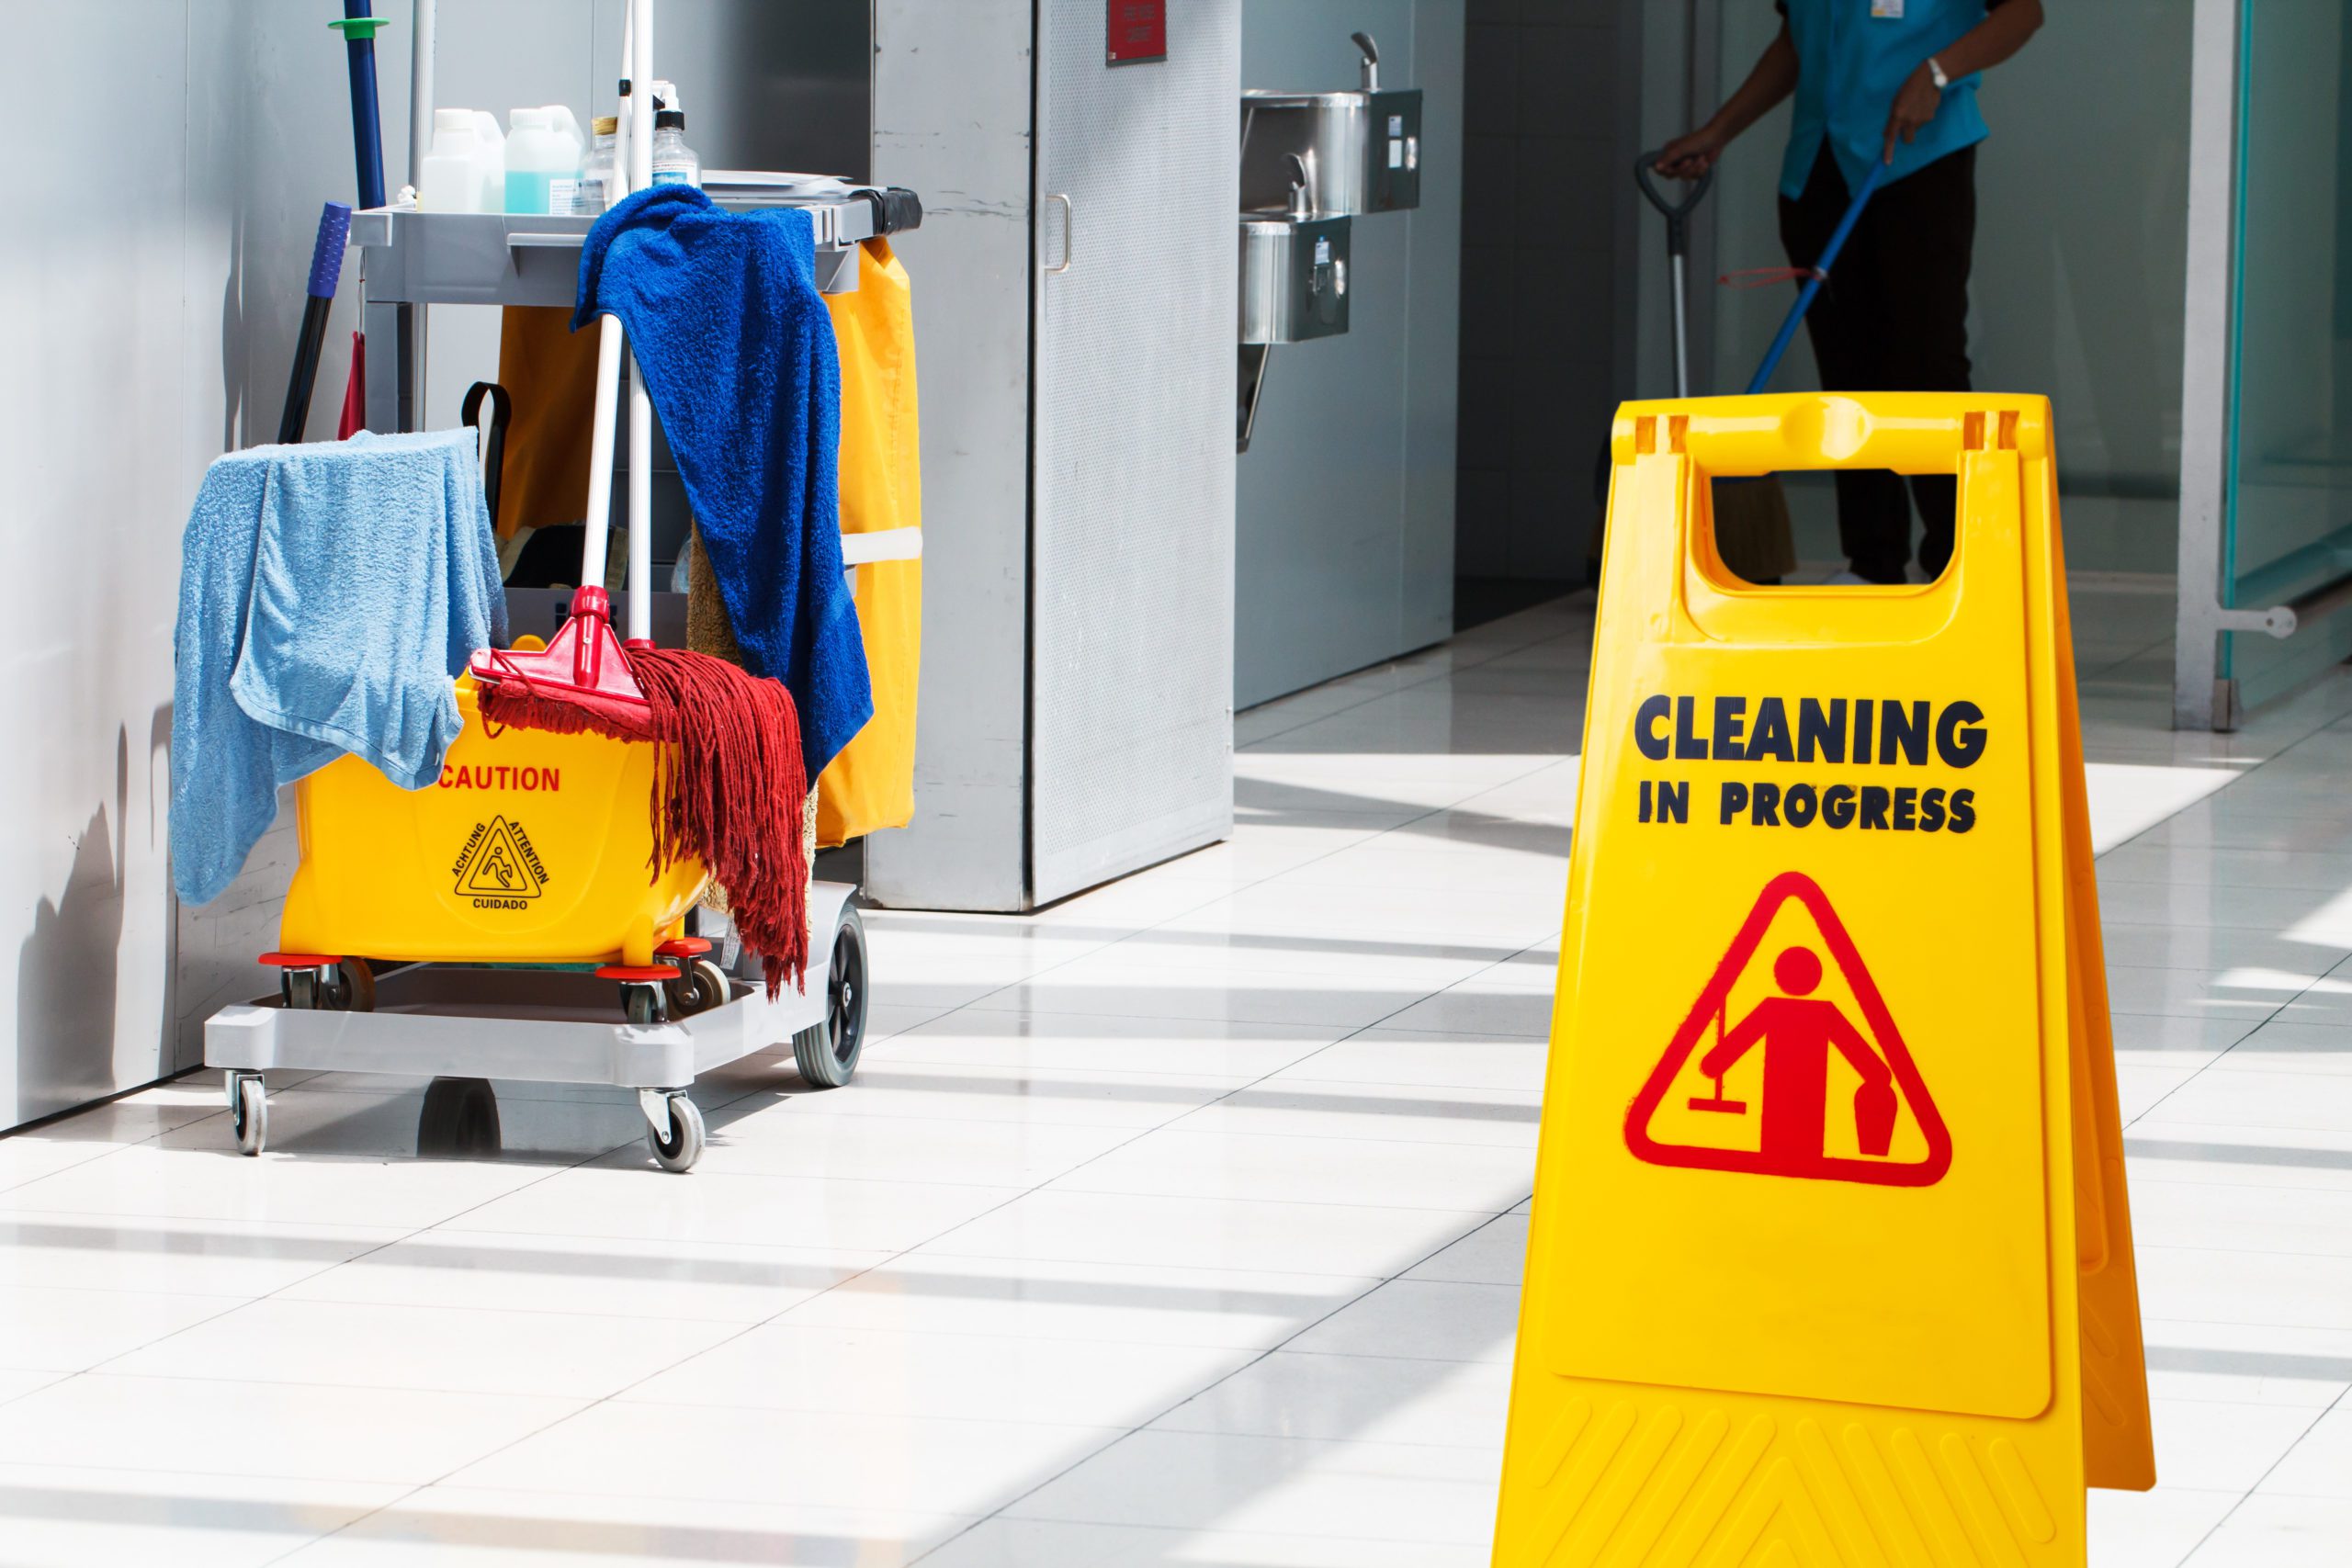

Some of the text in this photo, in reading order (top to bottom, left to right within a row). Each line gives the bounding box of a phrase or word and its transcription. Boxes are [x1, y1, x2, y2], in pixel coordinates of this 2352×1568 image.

[1634, 694, 1988, 769] CLEANING
[437, 763, 560, 792] CAUTION
[1638, 781, 1976, 834] IN PROGRESS
[451, 822, 486, 877] ACHTUNG
[508, 821, 550, 885] ATTENTION
[472, 898, 528, 910] CUIDADO
